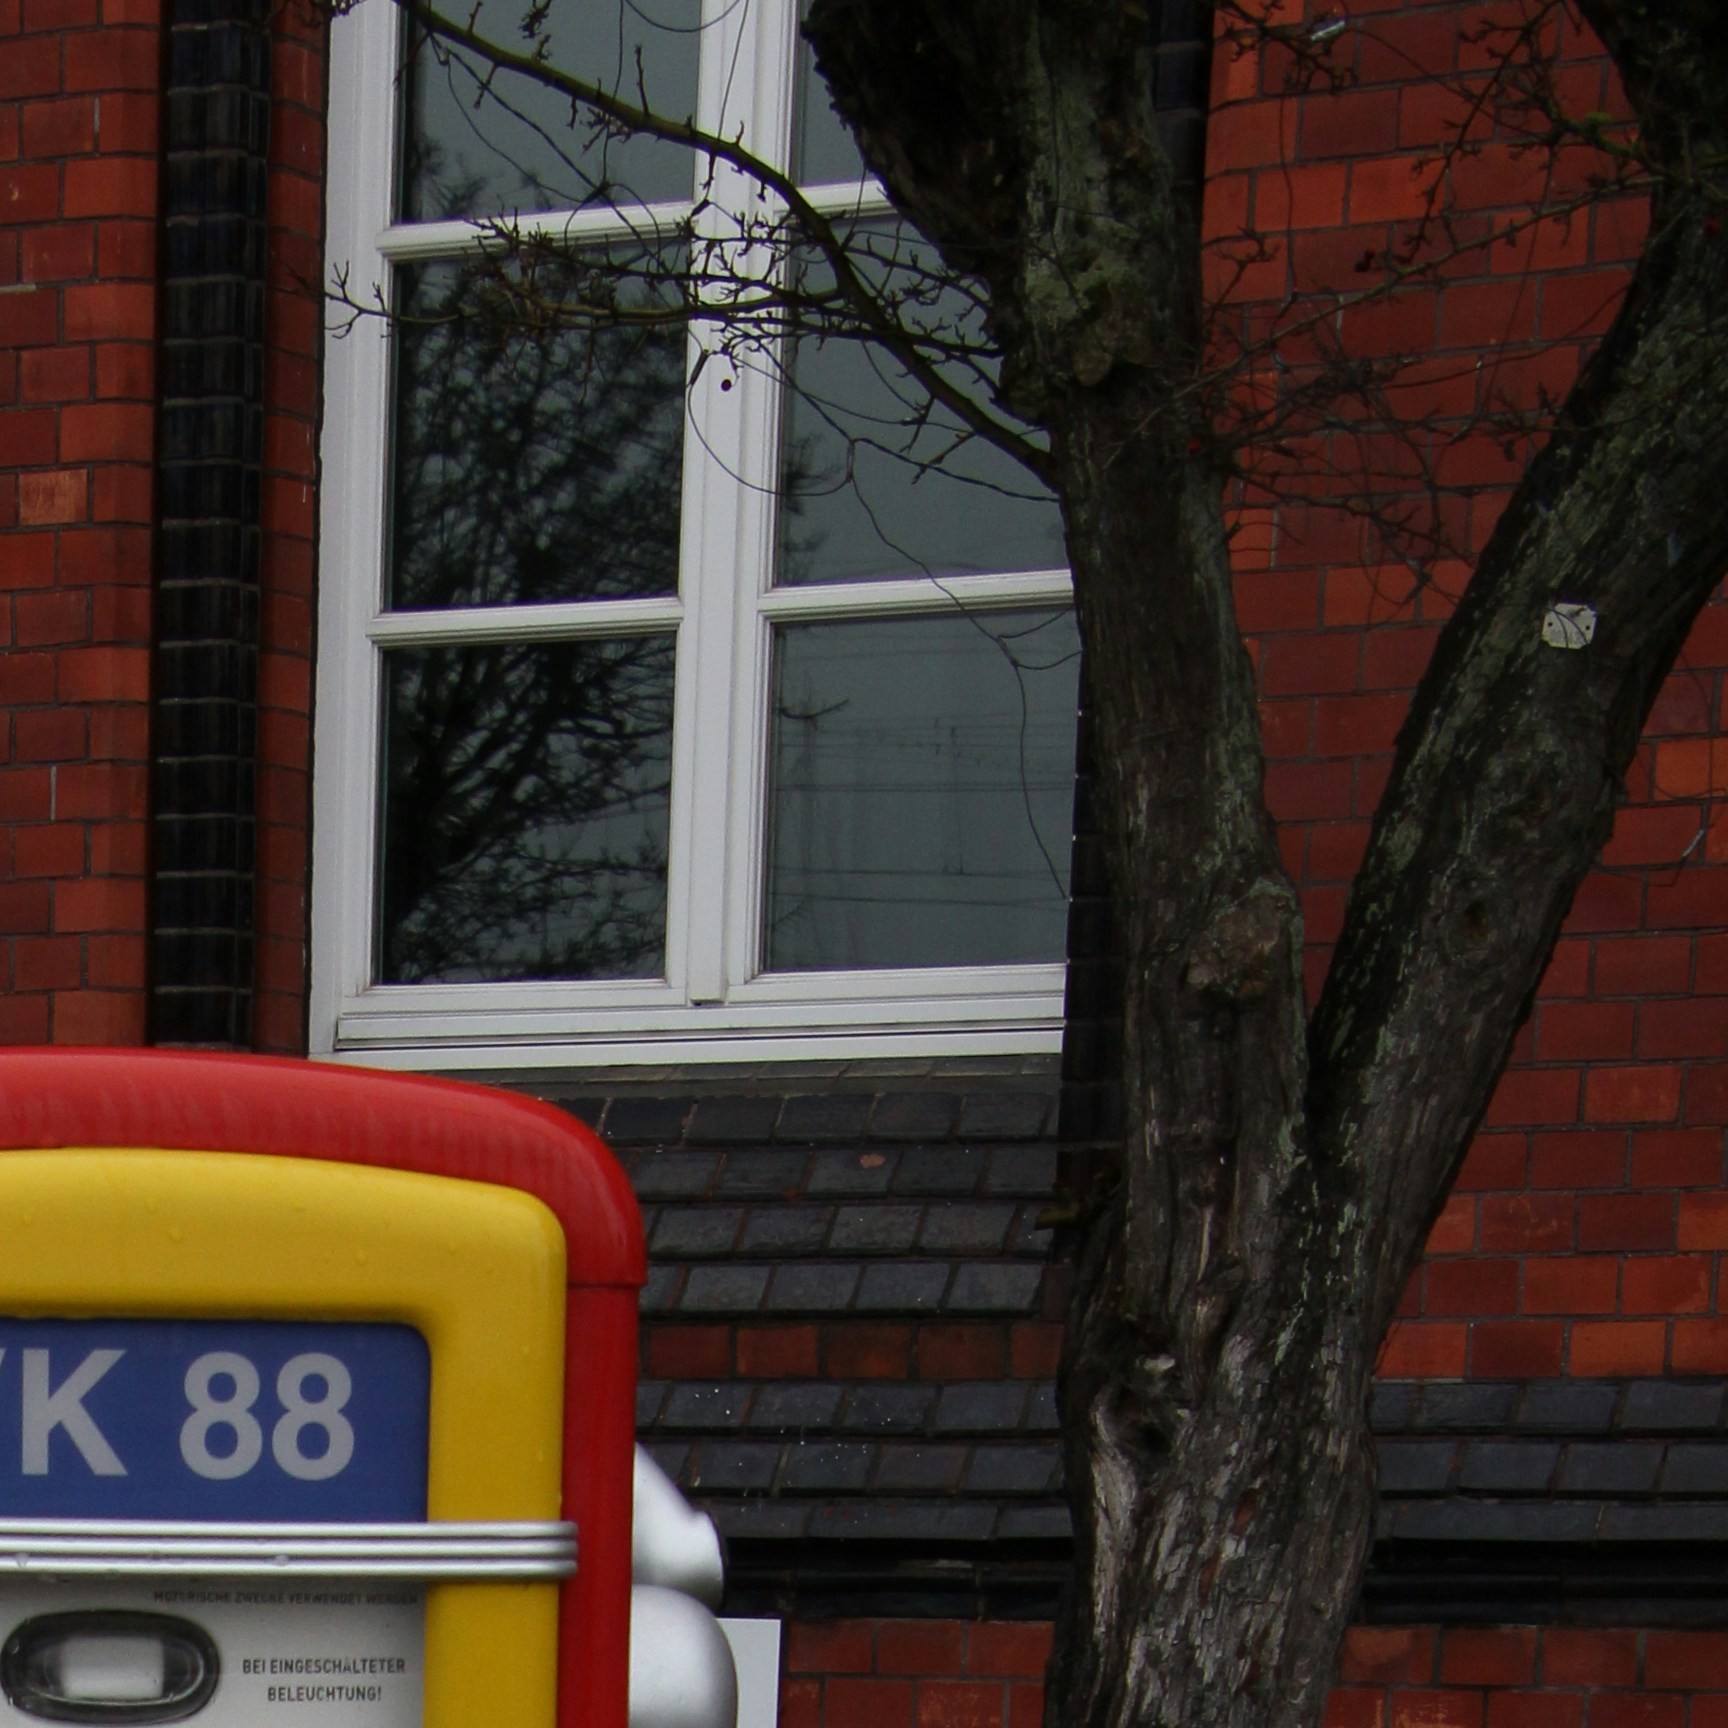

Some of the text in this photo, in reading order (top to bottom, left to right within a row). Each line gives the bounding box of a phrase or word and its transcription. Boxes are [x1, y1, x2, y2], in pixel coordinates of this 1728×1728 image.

[179, 1351, 354, 1481] 88
[243, 1658, 406, 1674] BEI EINGESCHALTETER
[268, 1686, 382, 1702] BELEUCHTUNG!
